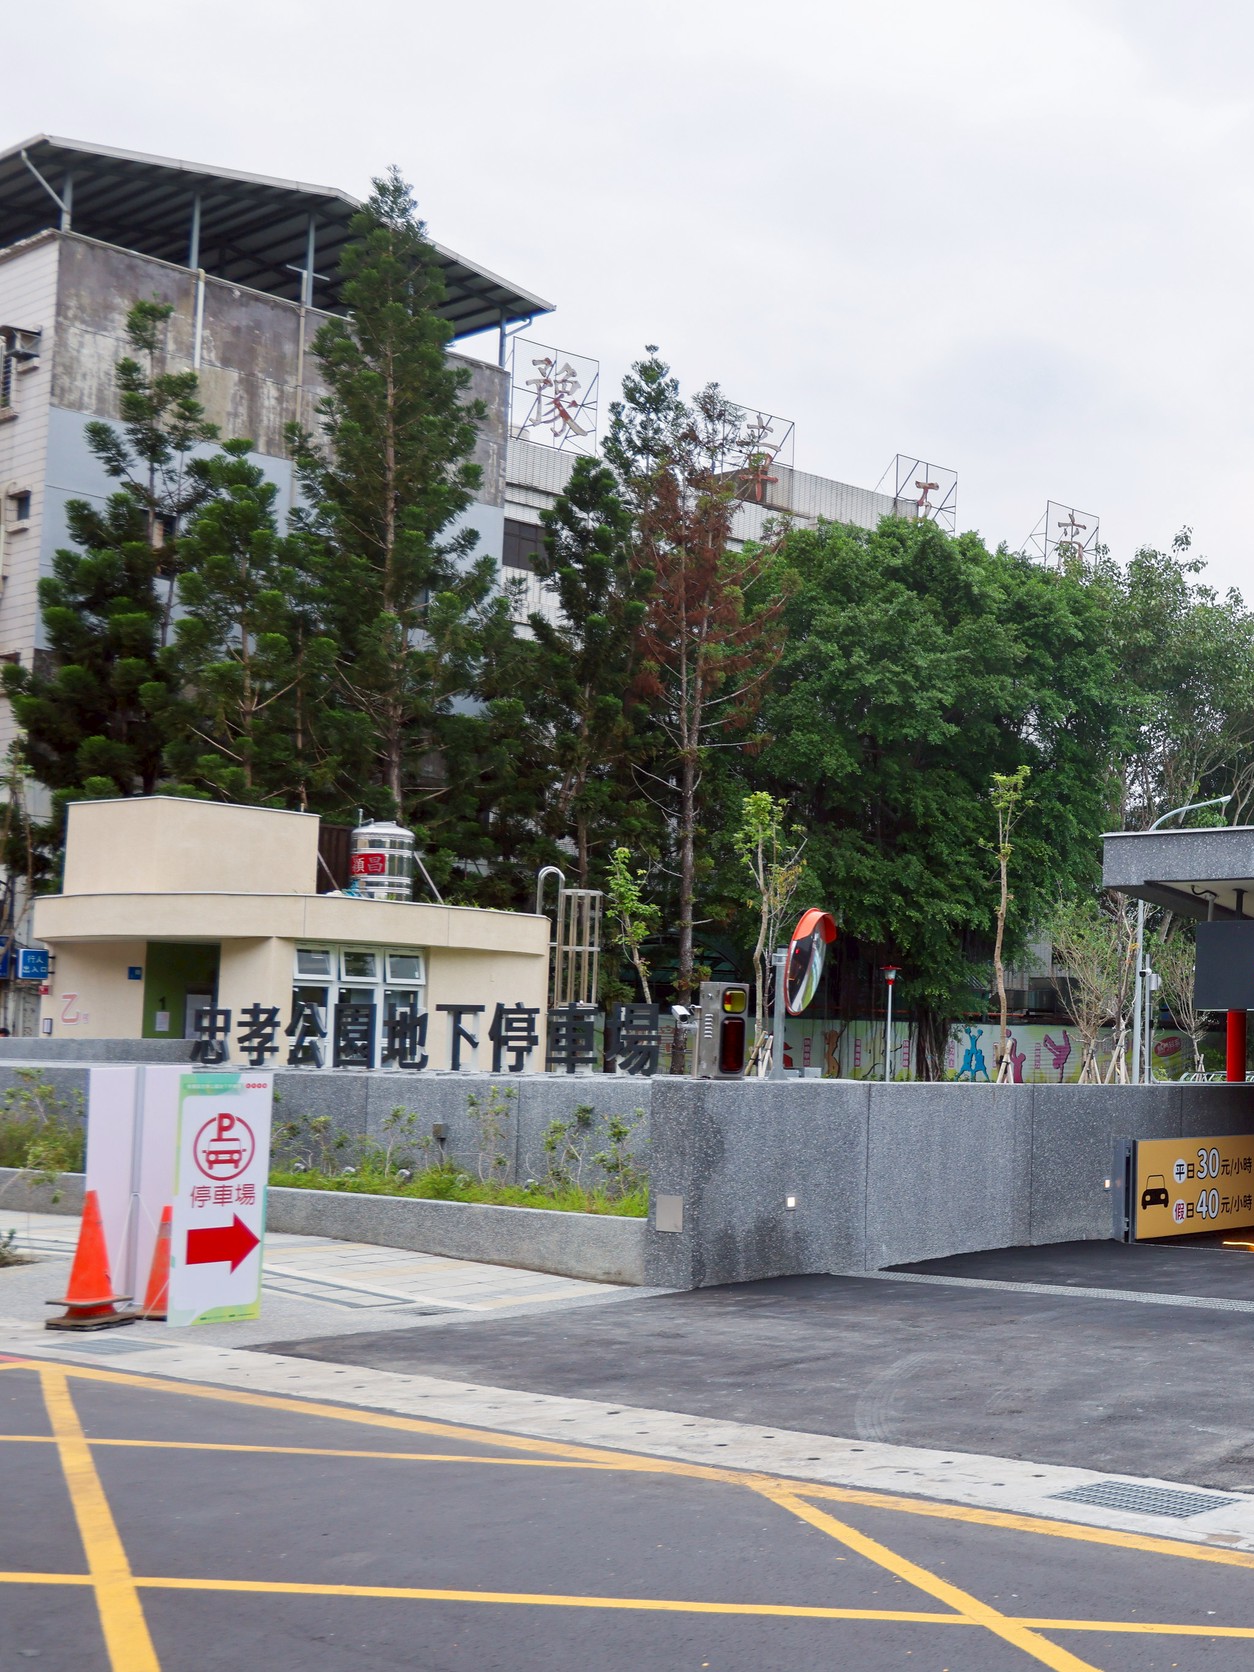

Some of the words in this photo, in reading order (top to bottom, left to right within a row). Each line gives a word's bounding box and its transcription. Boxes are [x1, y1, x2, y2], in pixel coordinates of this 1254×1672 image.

[22, 965, 47, 974] 出入口
[27, 955, 44, 963] 行人
[189, 1001, 662, 1076] 忠孝公園地下停車場
[1175, 1148, 1252, 1181] 平日30元/小時
[190, 1183, 255, 1208] 停車場
[1174, 1188, 1252, 1220] 假日40元/小時
